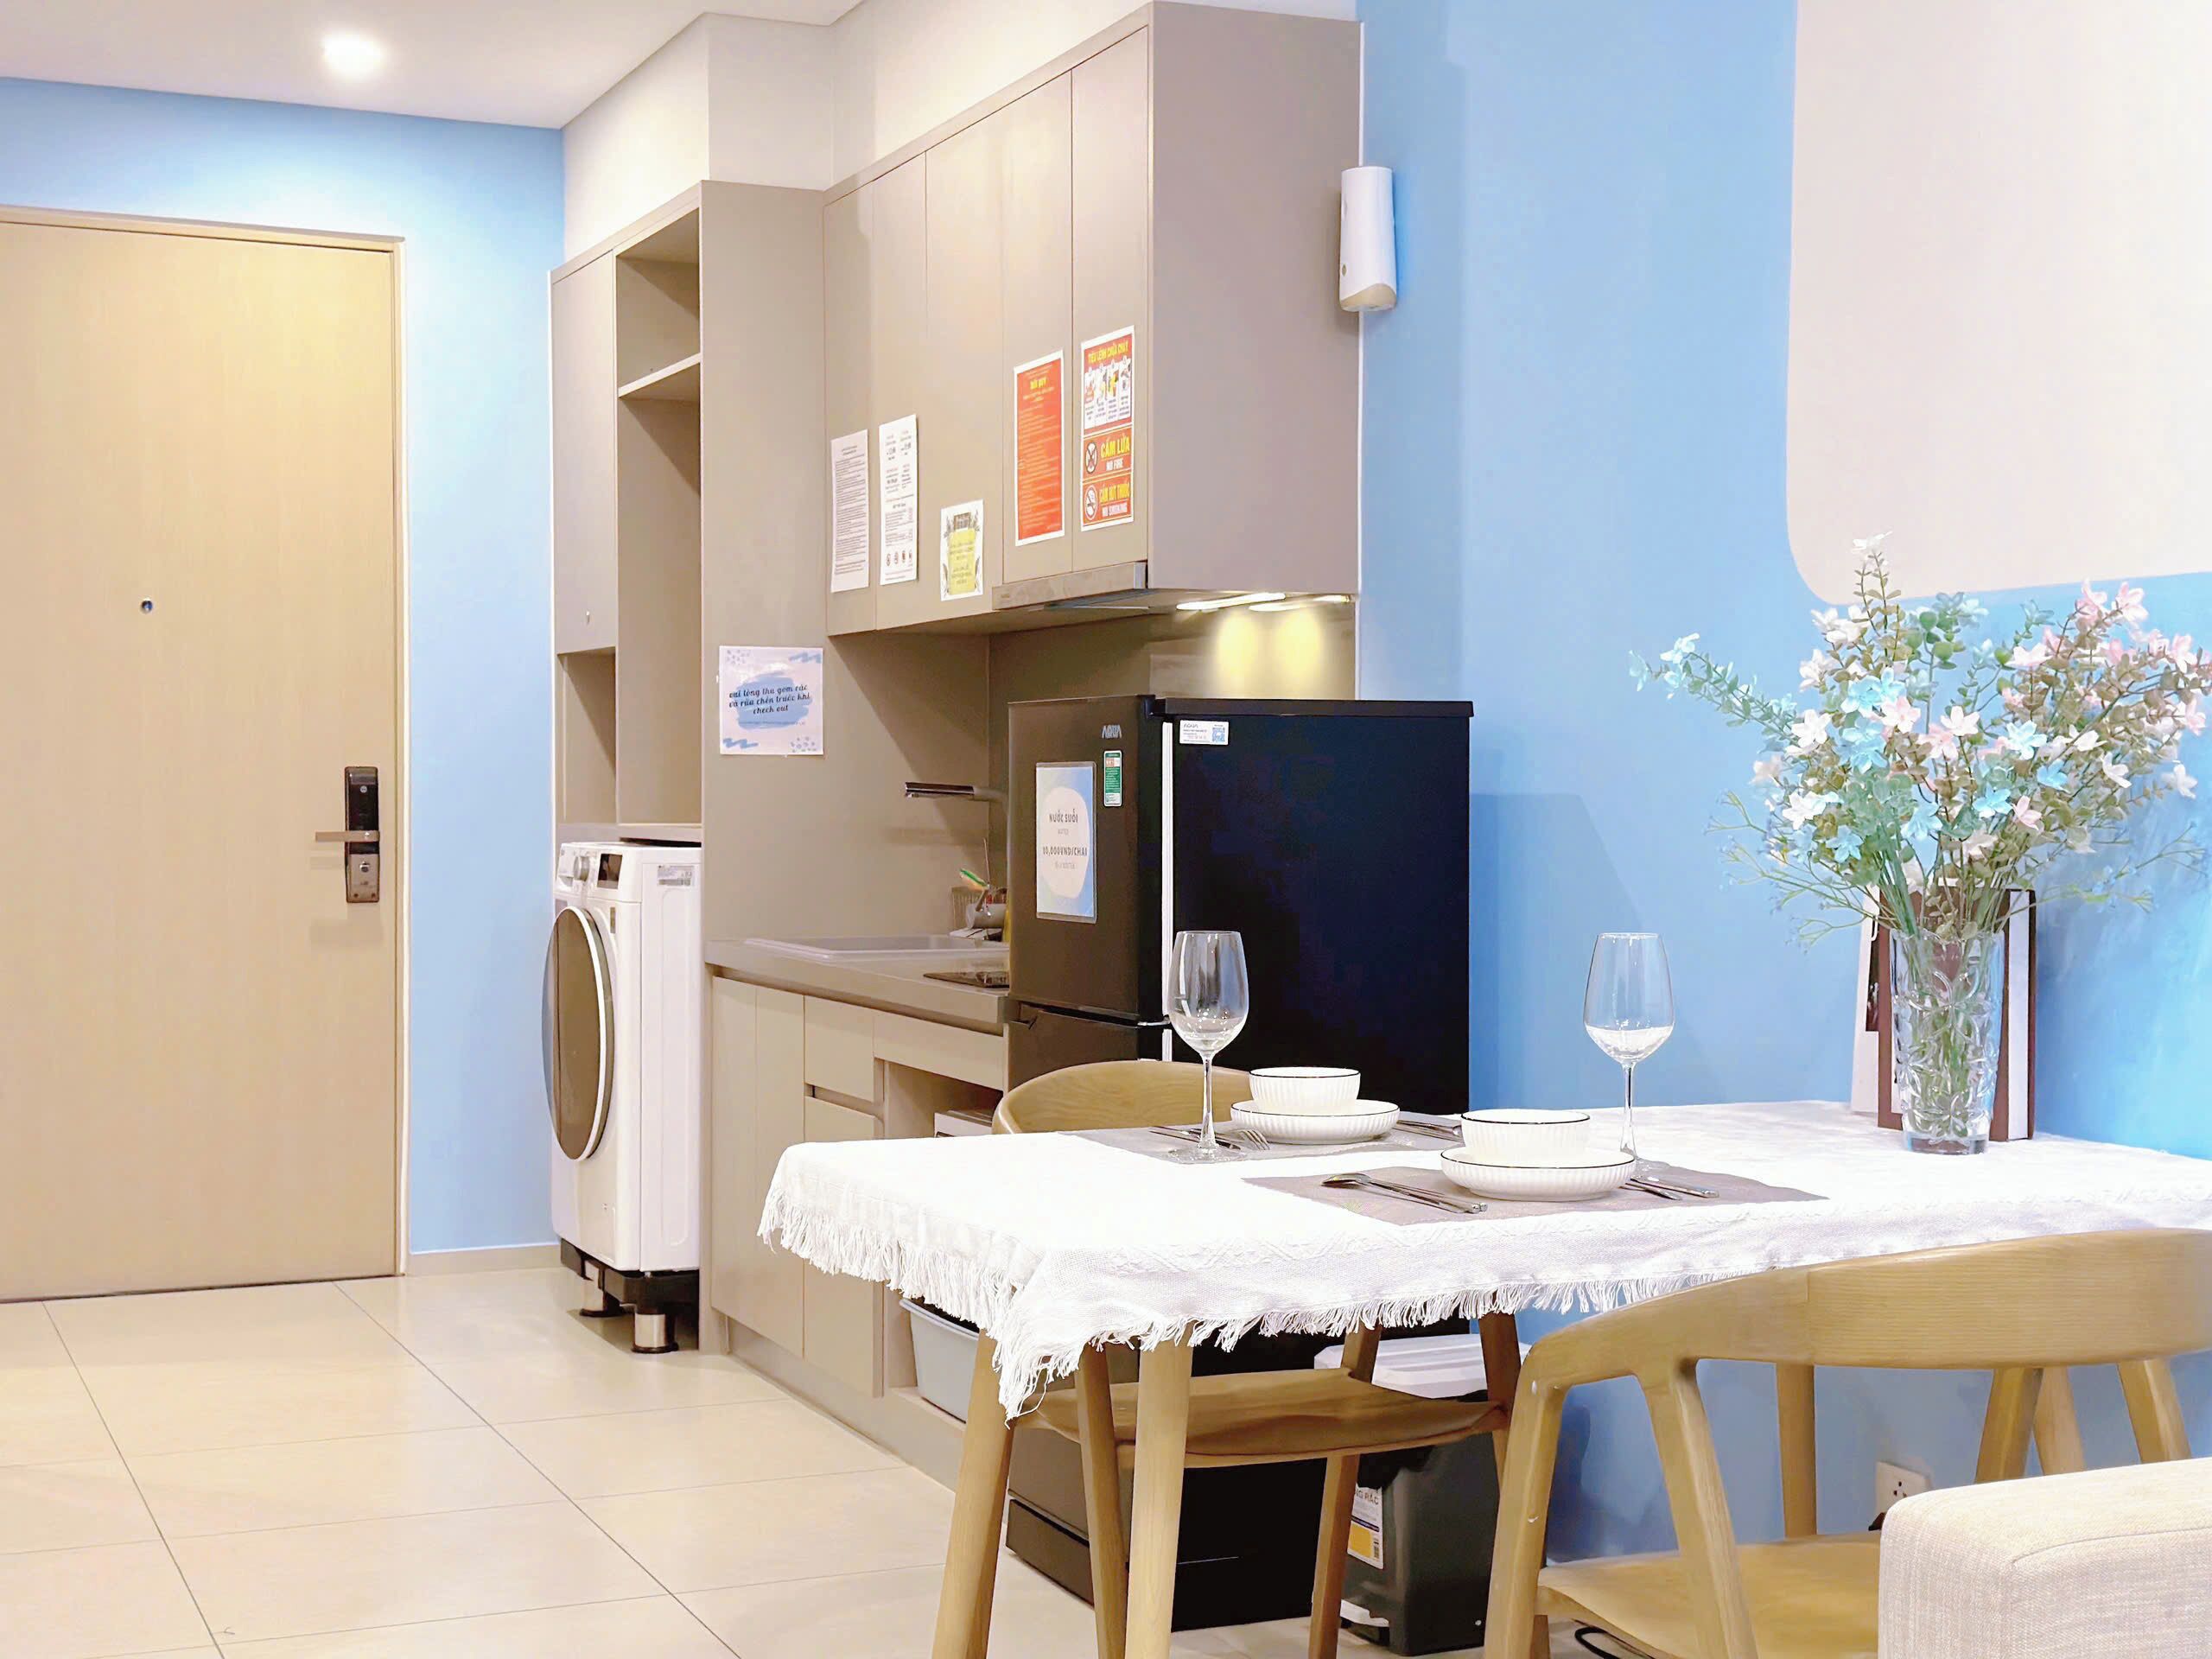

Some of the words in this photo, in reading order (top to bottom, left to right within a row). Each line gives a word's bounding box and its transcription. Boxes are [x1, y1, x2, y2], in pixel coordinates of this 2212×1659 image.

[743, 689, 760, 697] lòng
[778, 686, 793, 695] gom
[756, 696, 774, 705] chén
[798, 692, 810, 701] khi
